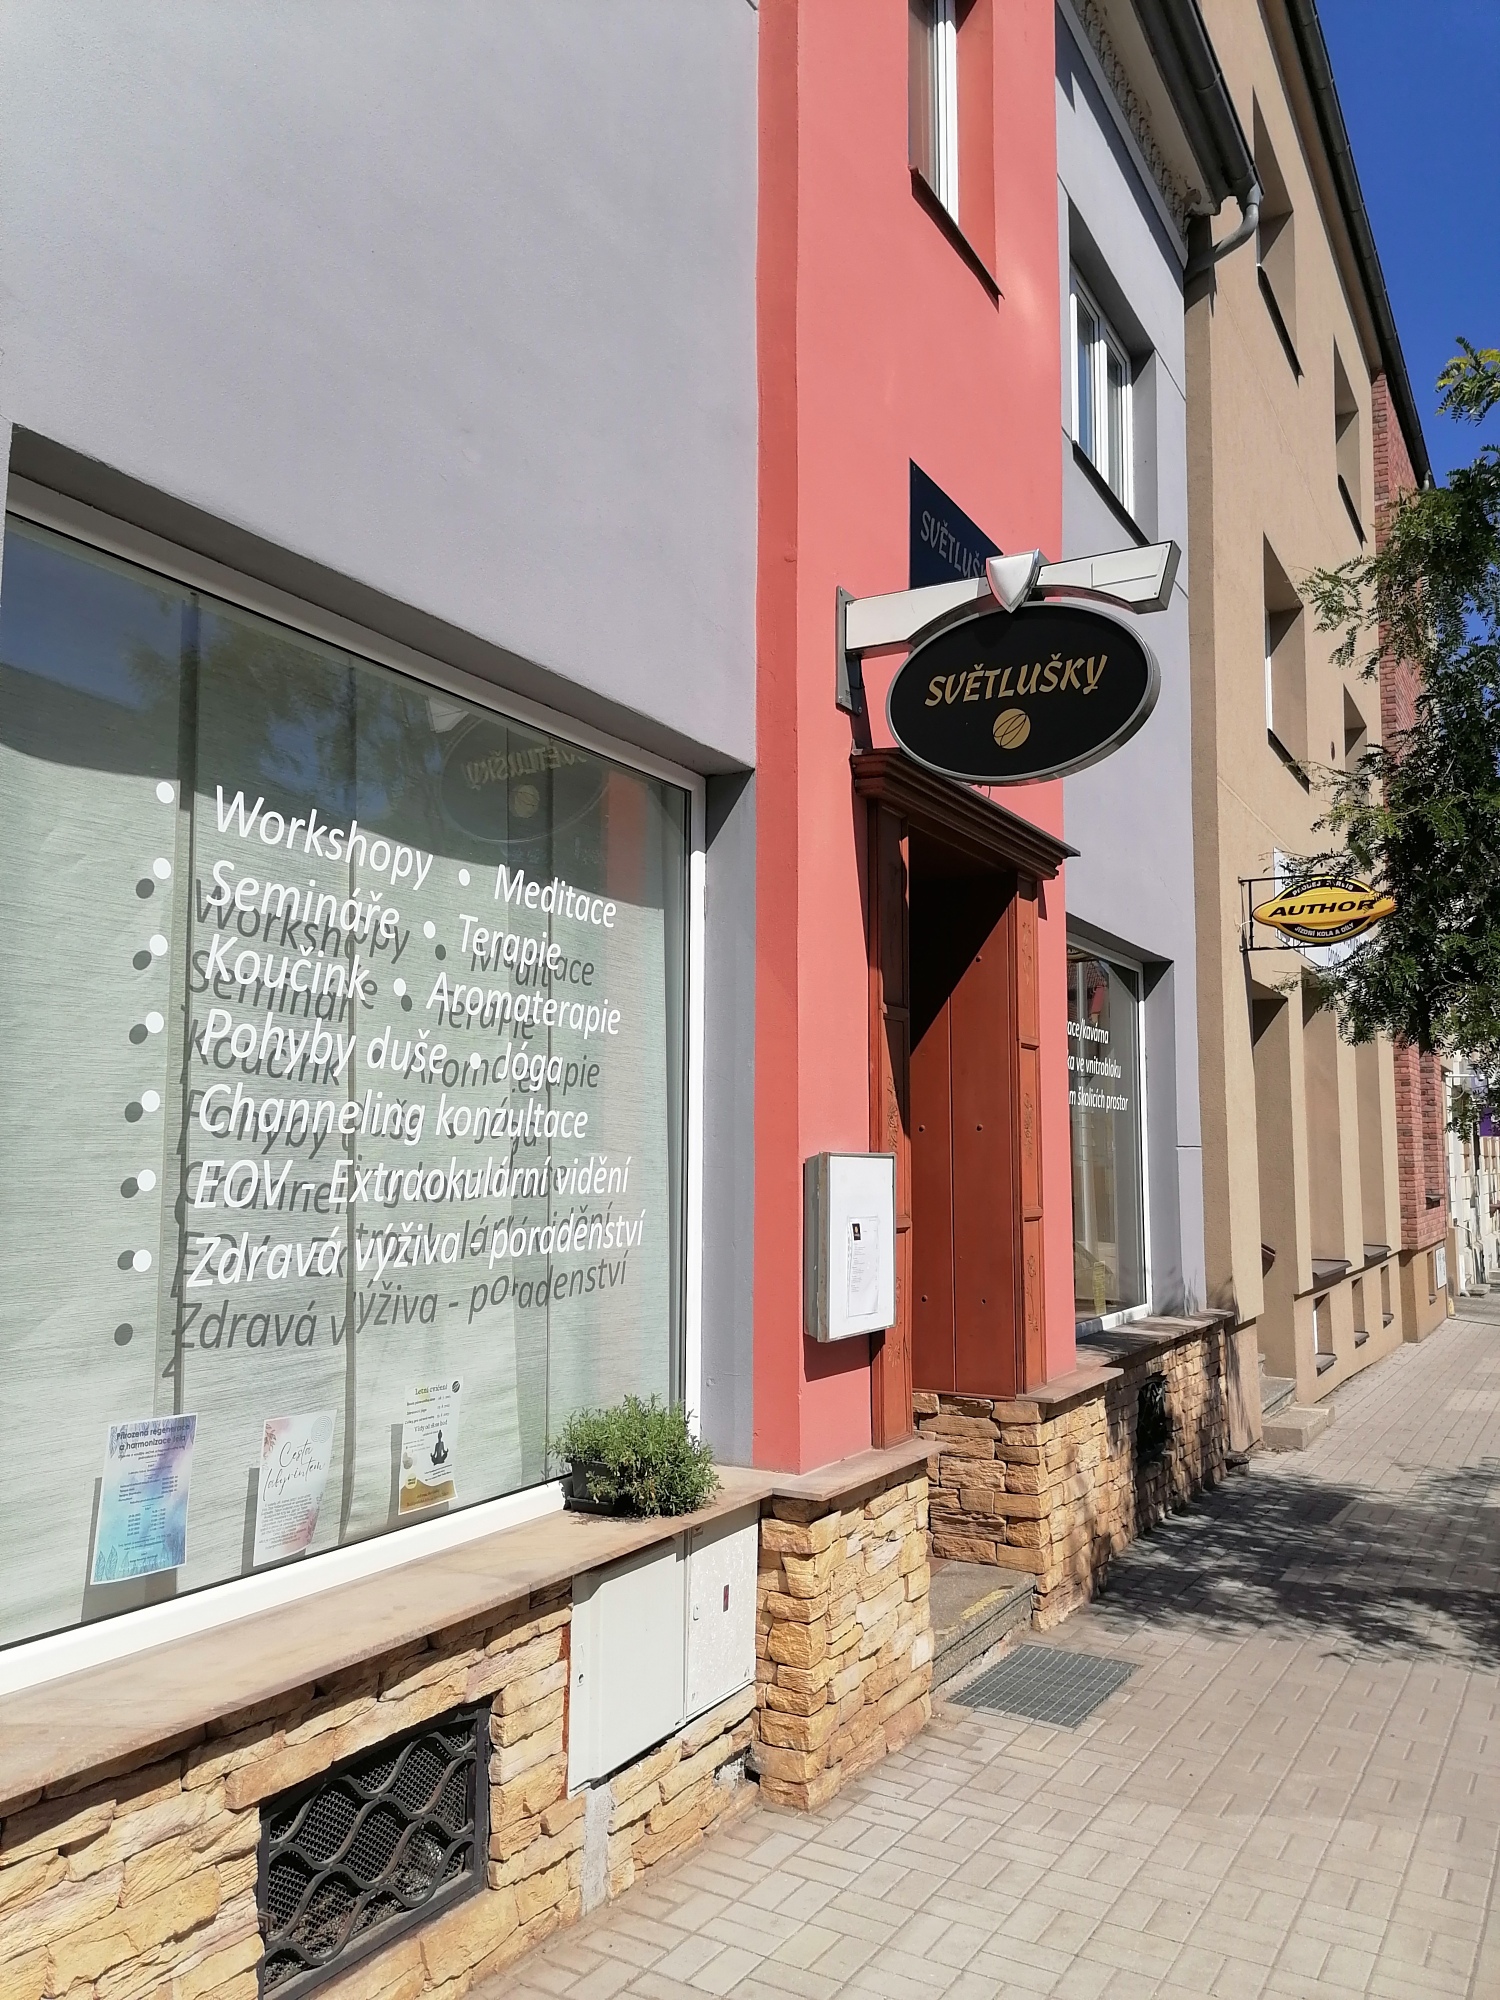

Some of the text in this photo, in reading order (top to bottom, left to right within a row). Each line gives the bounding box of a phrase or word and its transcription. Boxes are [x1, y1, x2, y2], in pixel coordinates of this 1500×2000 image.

[924, 653, 1108, 707] SVĚTLUŠKY
[216, 785, 617, 928] Workshopy Meditace
[206, 860, 562, 974] Semináře Terapie
[1268, 900, 1376, 917] AUTHOR
[204, 933, 621, 1040] Koučink Aromaterapie
[201, 1008, 564, 1091] Pohyby duše Jóga
[1076, 1057, 1085, 1073] ve
[1086, 1055, 1121, 1079] vnitrobloku
[199, 1082, 589, 1146] Channeling konzultace
[1105, 1094, 1128, 1113] prostor
[193, 1159, 294, 1209] EOV
[328, 1156, 551, 1204] Extraokulární
[556, 1156, 632, 1195] vidění
[186, 1226, 343, 1288] Zdravá
[355, 1221, 461, 1282] výživa
[488, 1209, 647, 1270] poradenství
[126, 1436, 171, 1449] harmonizace
[279, 1439, 314, 1468] Cesta
